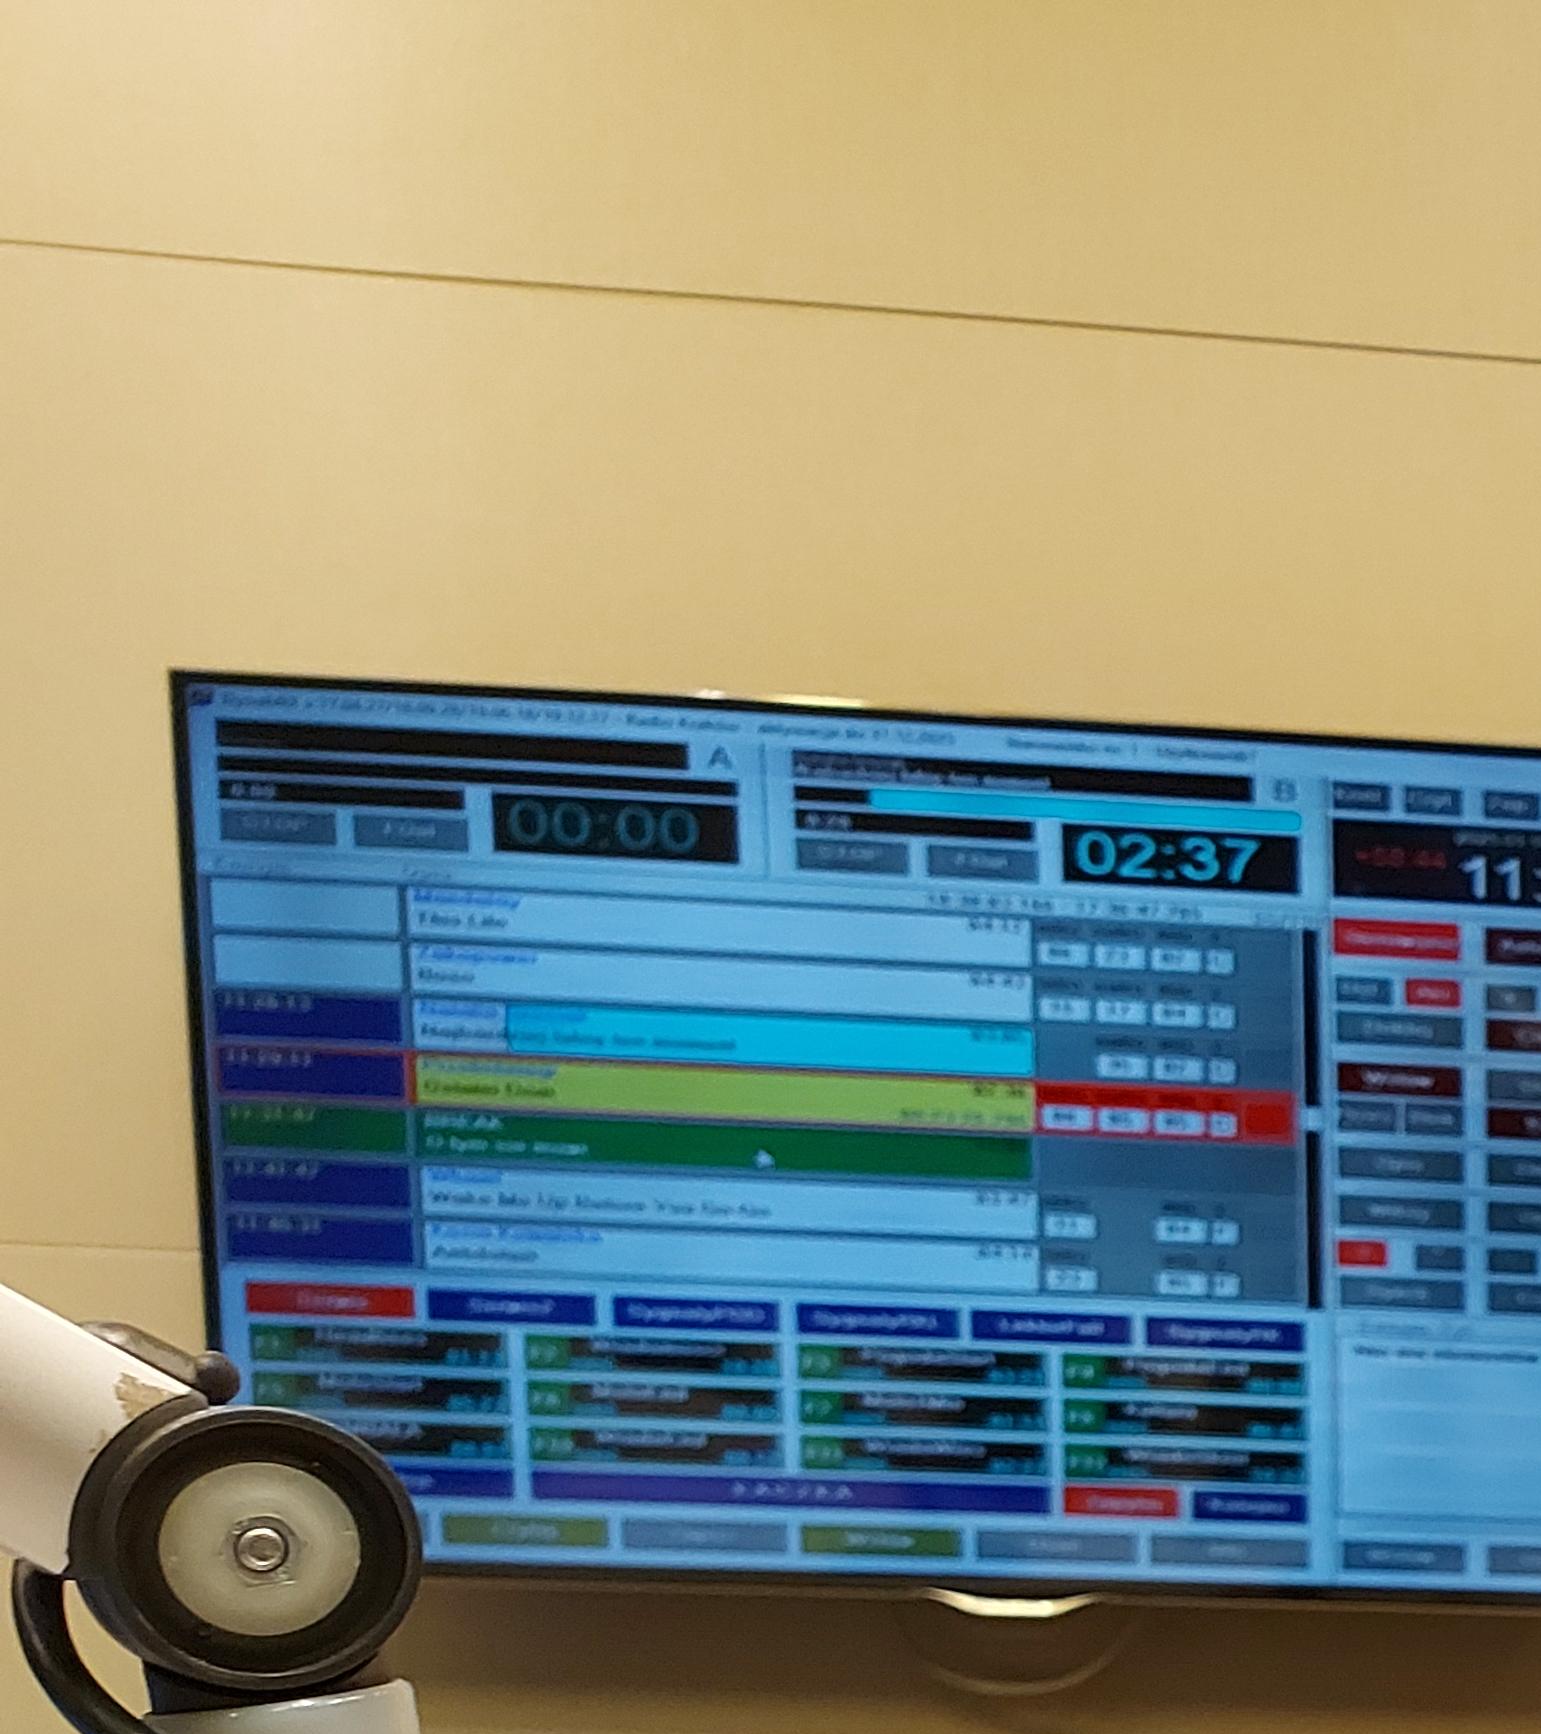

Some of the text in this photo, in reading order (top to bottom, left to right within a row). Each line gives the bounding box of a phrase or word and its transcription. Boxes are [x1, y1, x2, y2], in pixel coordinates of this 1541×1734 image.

[705, 746, 733, 770] A
[507, 800, 699, 852] 00:00
[1075, 829, 1262, 884] 02:37
